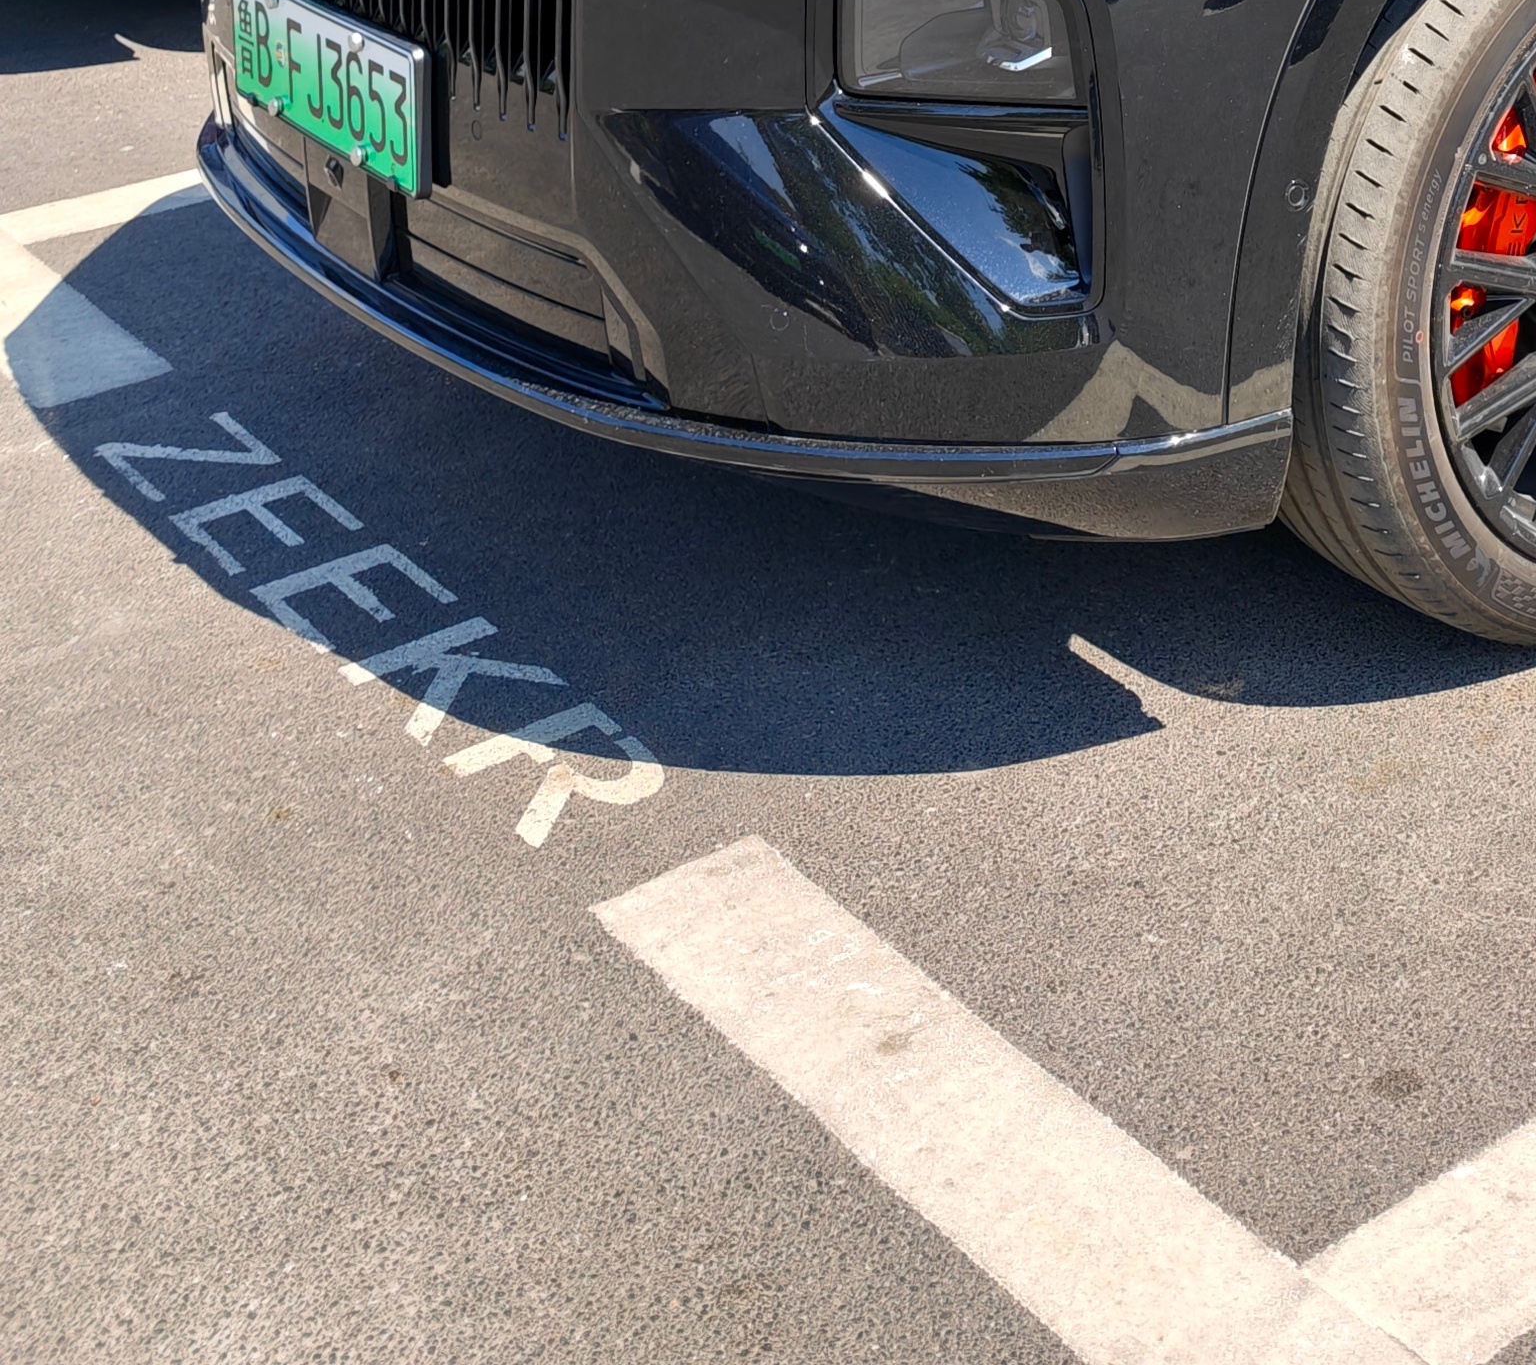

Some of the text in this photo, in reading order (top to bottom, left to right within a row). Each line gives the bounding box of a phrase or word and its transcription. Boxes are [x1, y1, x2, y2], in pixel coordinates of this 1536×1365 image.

[1420, 168, 1442, 222] energy
[1406, 236, 1426, 303] SPORT
[1402, 306, 1416, 363] PILOT
[1397, 397, 1472, 560] MICHELIN
[93, 411, 665, 849] ZEEKR
